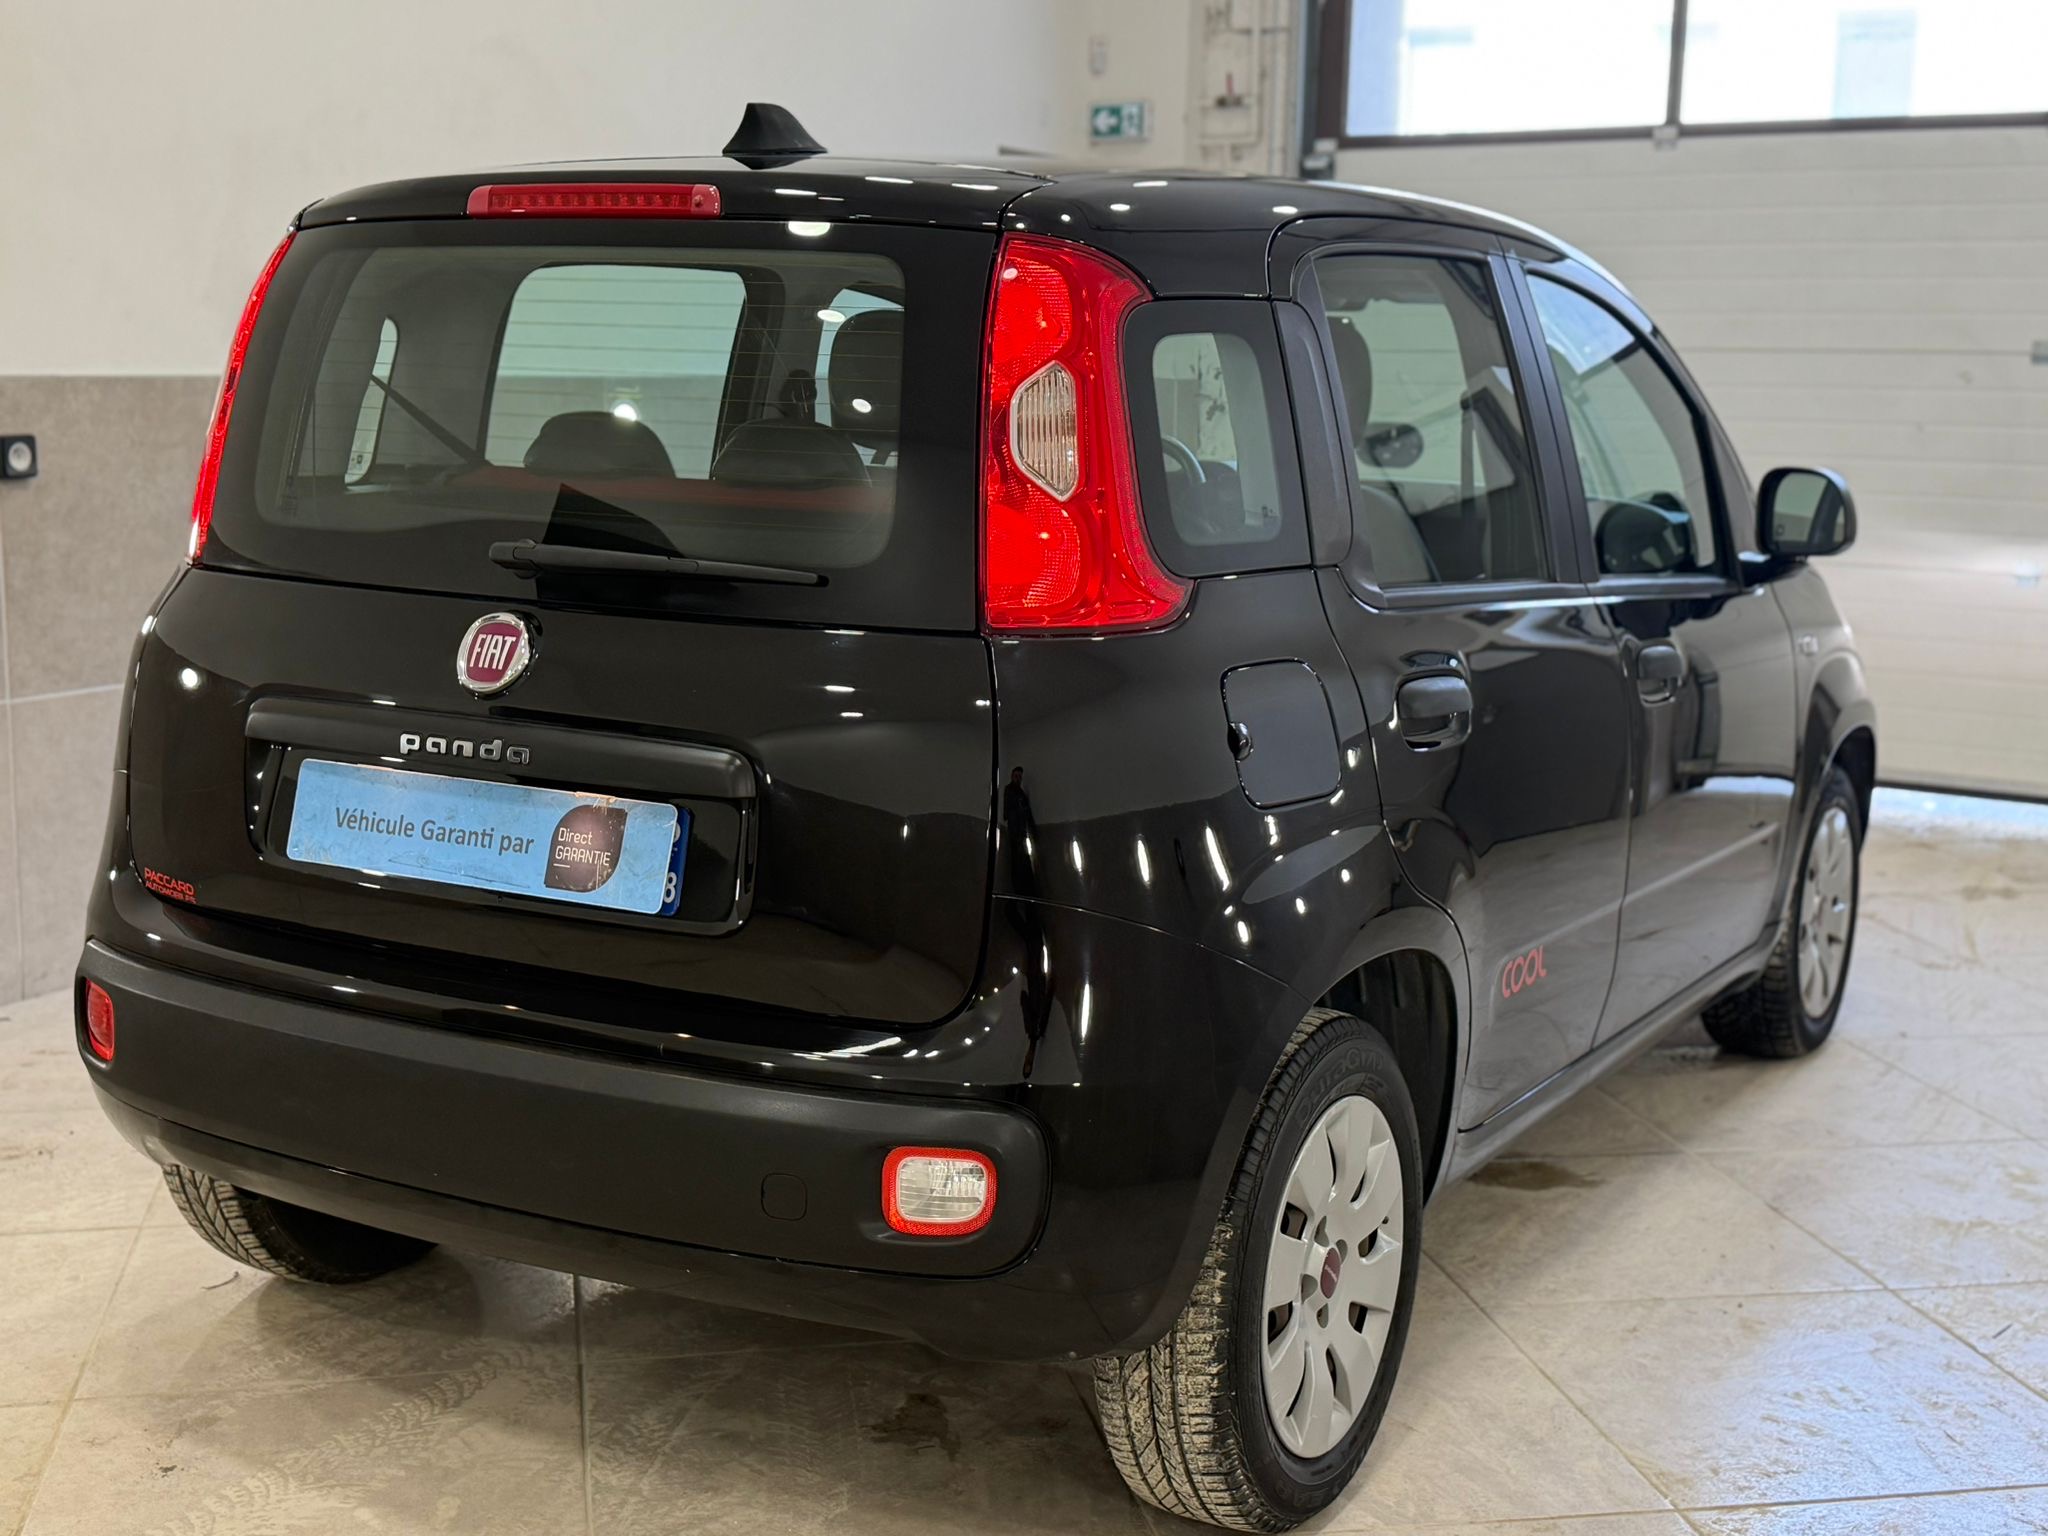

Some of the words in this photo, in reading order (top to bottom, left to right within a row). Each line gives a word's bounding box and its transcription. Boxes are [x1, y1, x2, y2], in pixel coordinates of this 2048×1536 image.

[469, 633, 517, 670] FIAT
[400, 733, 530, 765] panda
[336, 806, 415, 838] Véhicule
[420, 819, 495, 849] Garanti
[498, 833, 535, 856] par
[558, 827, 593, 846] Direct
[555, 845, 612, 867] GARANTIE
[144, 866, 195, 896] PACCARD
